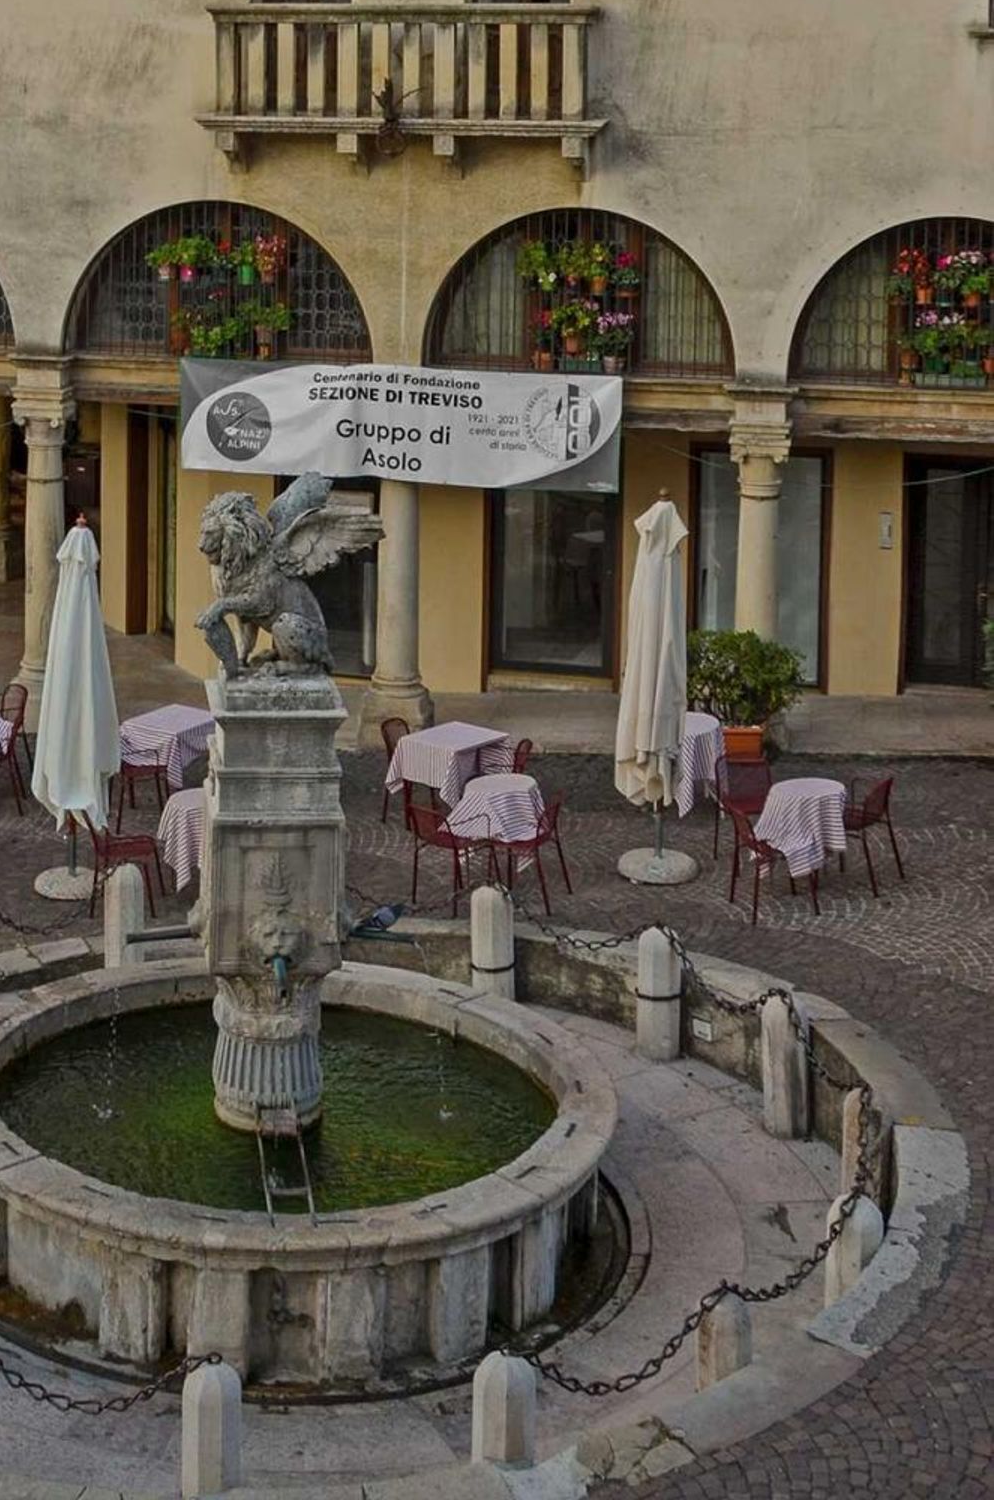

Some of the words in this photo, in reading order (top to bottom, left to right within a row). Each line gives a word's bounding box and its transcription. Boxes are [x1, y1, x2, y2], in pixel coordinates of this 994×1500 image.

[313, 371, 382, 384] Centenario
[386, 373, 399, 384] di
[403, 374, 481, 390] Fondazione
[308, 387, 380, 402] SEZIONE
[385, 389, 403, 403] DI
[409, 391, 483, 409] TREVISO
[468, 413, 488, 424] 1921
[497, 415, 519, 424] 2021
[336, 419, 422, 445] Gruppo
[429, 426, 451, 445] di
[468, 427, 496, 436] cento
[227, 439, 261, 450] ALPINI
[361, 447, 422, 472] Asolo
